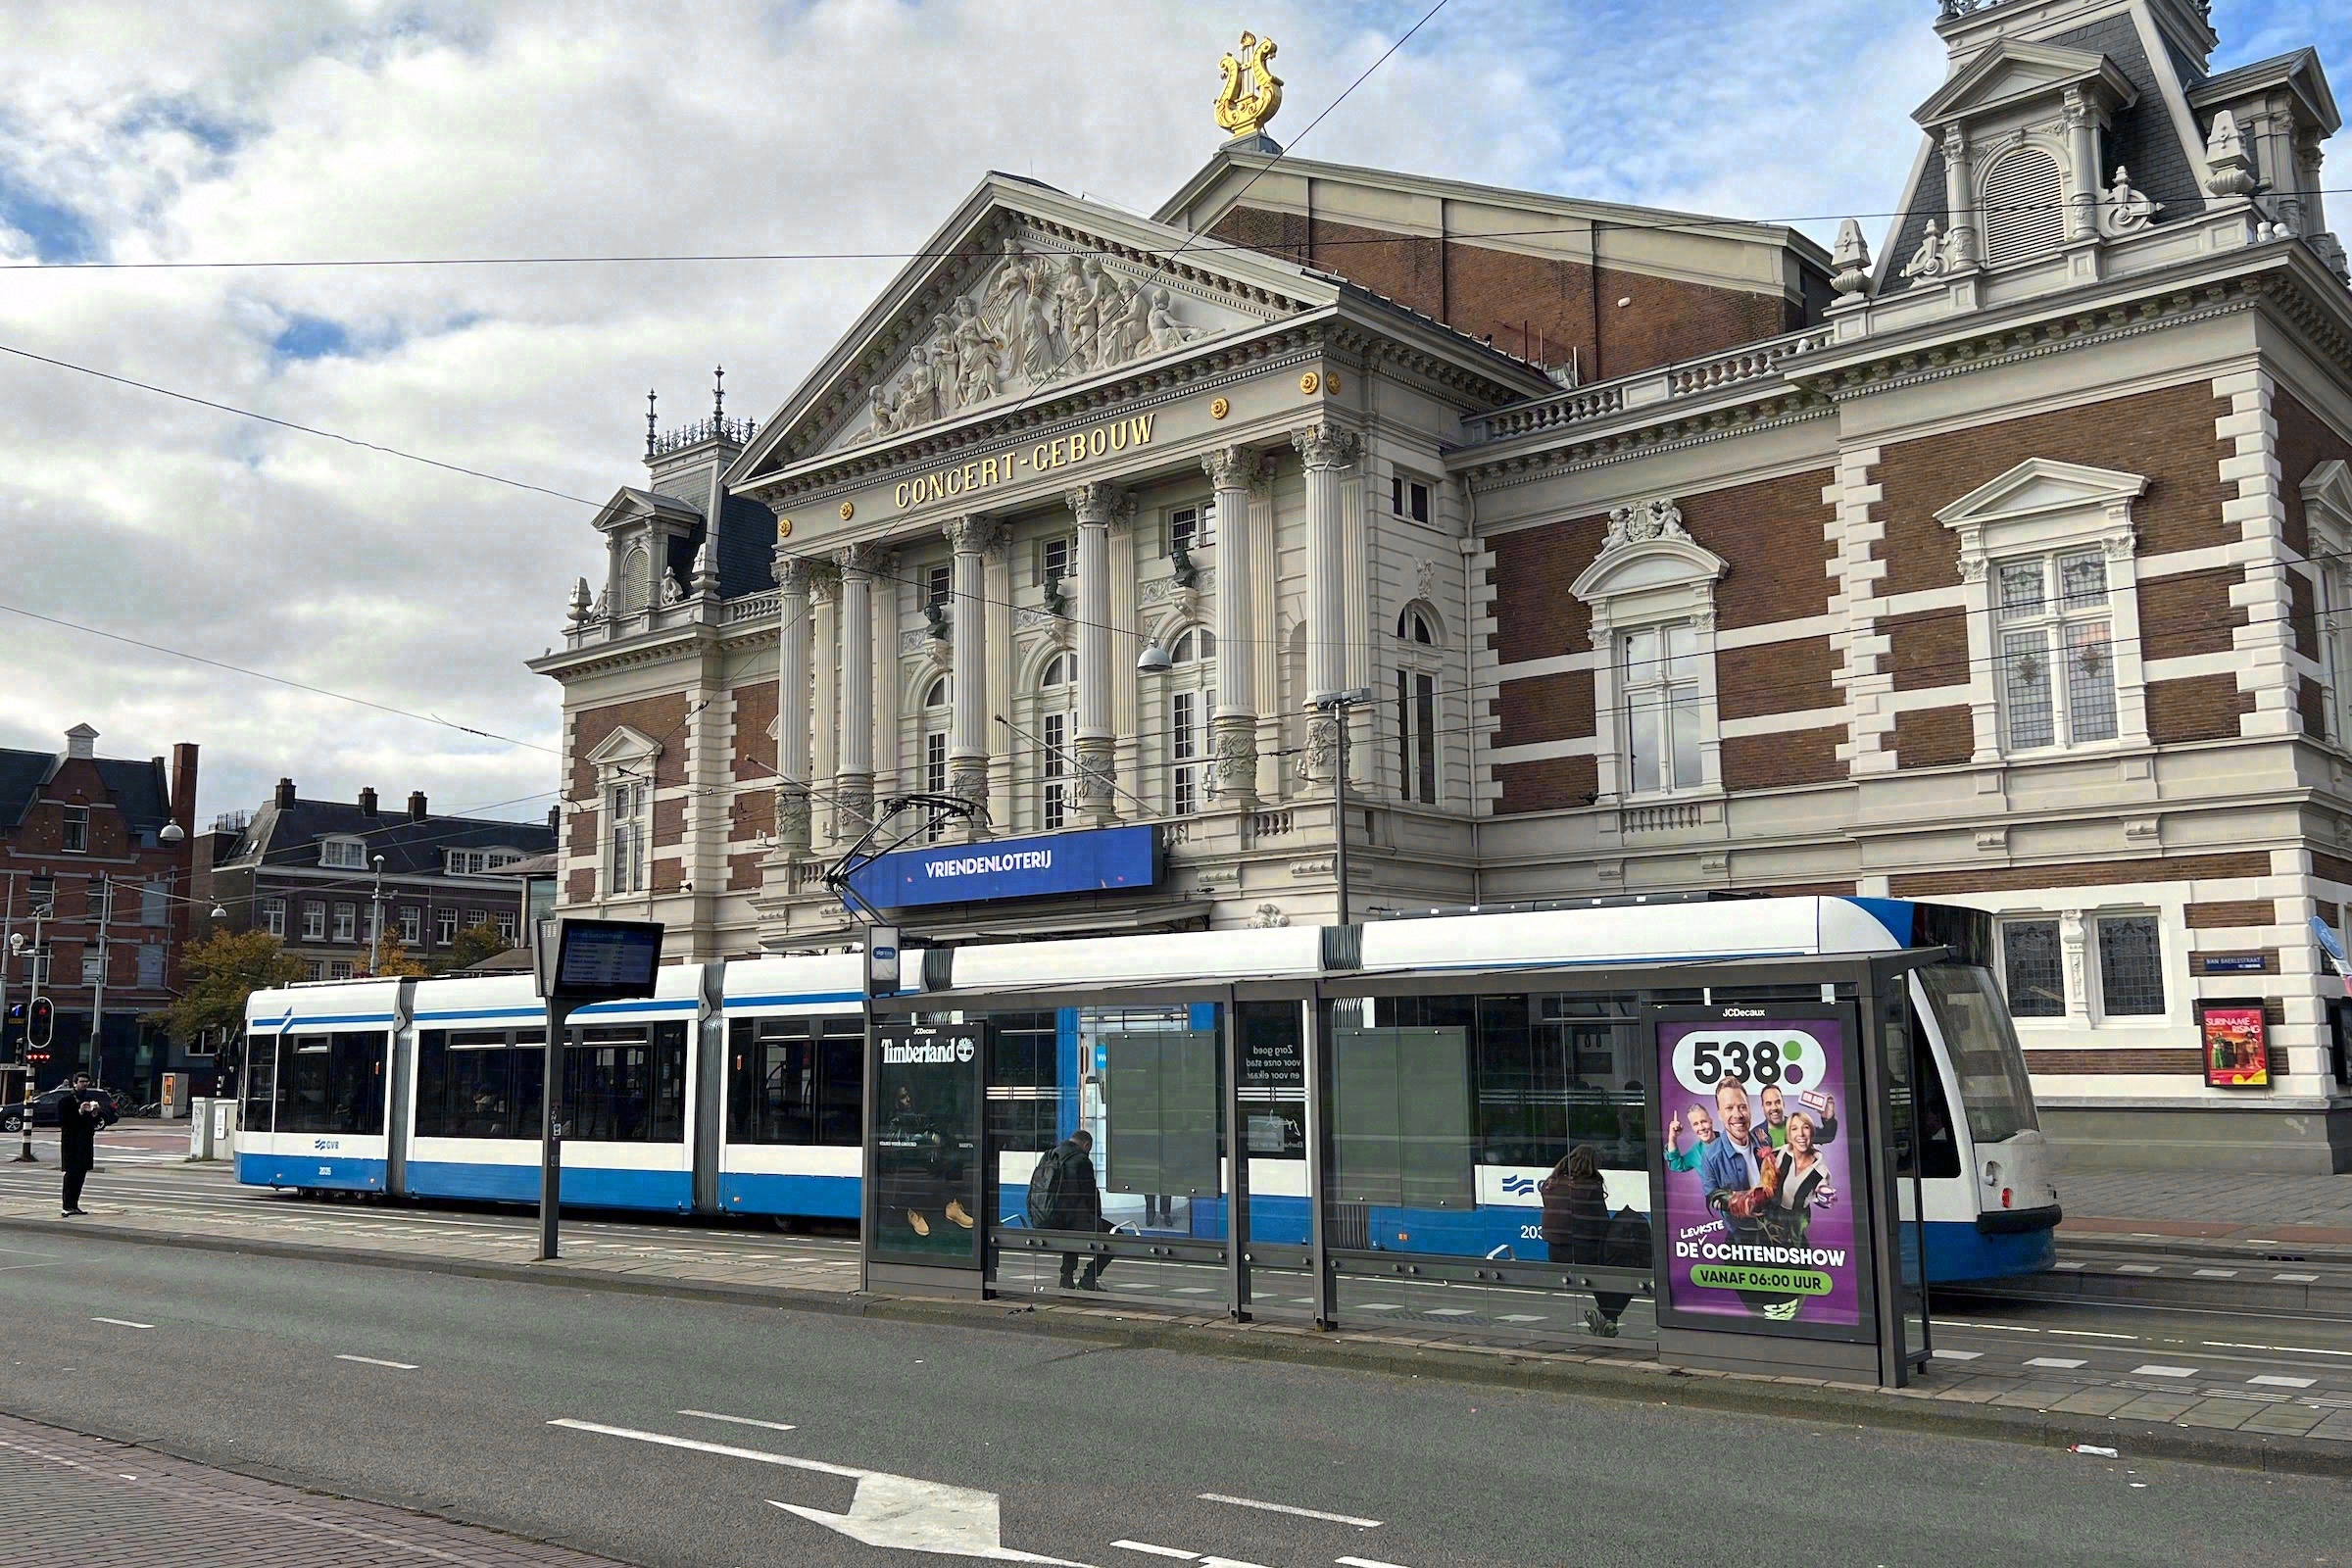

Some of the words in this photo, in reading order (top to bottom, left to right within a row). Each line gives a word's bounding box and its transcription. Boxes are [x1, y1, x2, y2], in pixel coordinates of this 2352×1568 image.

[895, 413, 1155, 508] CONCERT-GEBOUW
[925, 850, 1052, 878] VRIENDENLOTERIJ
[1722, 1007, 1766, 1018] JCDecaux
[2205, 1017, 2250, 1026] SURINAME
[2231, 1024, 2261, 1034] RISING
[881, 1037, 956, 1064] Timberland
[326, 1141, 339, 1150] GVB
[1520, 1224, 1544, 1240] 203
[1680, 1219, 1725, 1240] LEUKSTE
[1675, 1241, 1699, 1259] DE
[1701, 1243, 1845, 1267] OCHTENDSHOW
[1699, 1269, 1746, 1285] VANAF
[1748, 1273, 1790, 1289] 06:00
[1793, 1276, 1823, 1291] UUR
